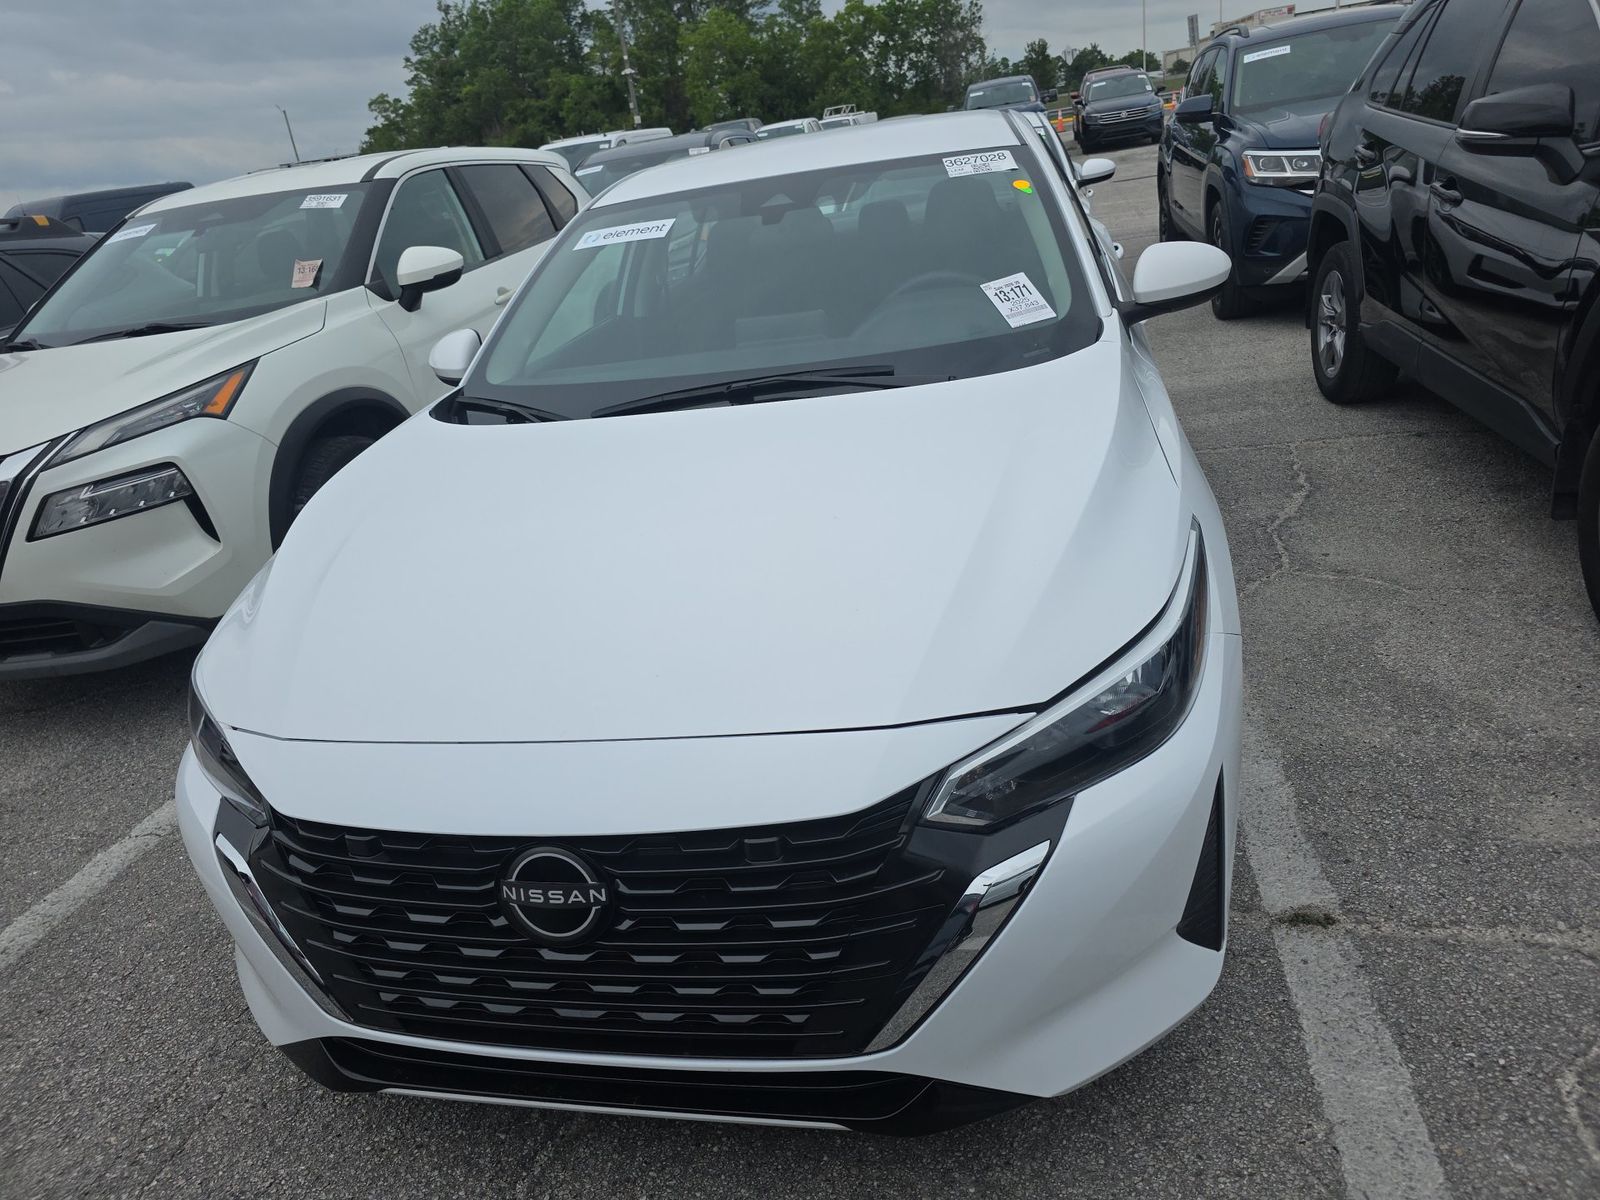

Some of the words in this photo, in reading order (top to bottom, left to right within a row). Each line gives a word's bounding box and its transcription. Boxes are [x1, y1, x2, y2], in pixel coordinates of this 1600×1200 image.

[944, 152, 1007, 168] 3627028
[602, 223, 667, 240] element
[993, 283, 1033, 304] 13:171
[1010, 297, 1030, 307] 2025
[502, 885, 607, 904] NISSAN
